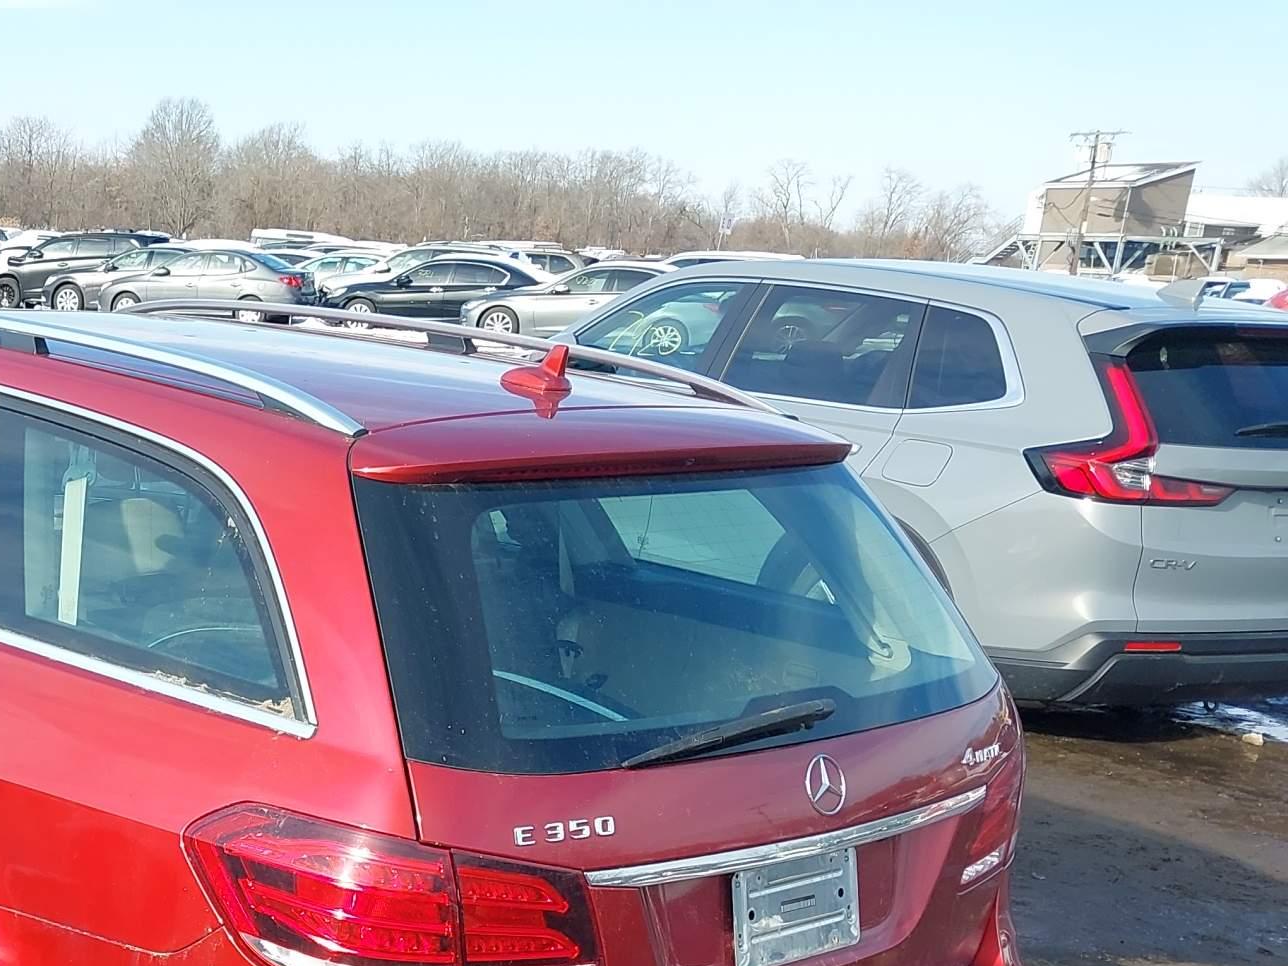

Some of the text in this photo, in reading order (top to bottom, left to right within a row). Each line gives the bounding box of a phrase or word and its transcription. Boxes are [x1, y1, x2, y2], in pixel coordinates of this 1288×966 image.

[1150, 559, 1198, 571] CR-V
[513, 816, 616, 846] E 350
